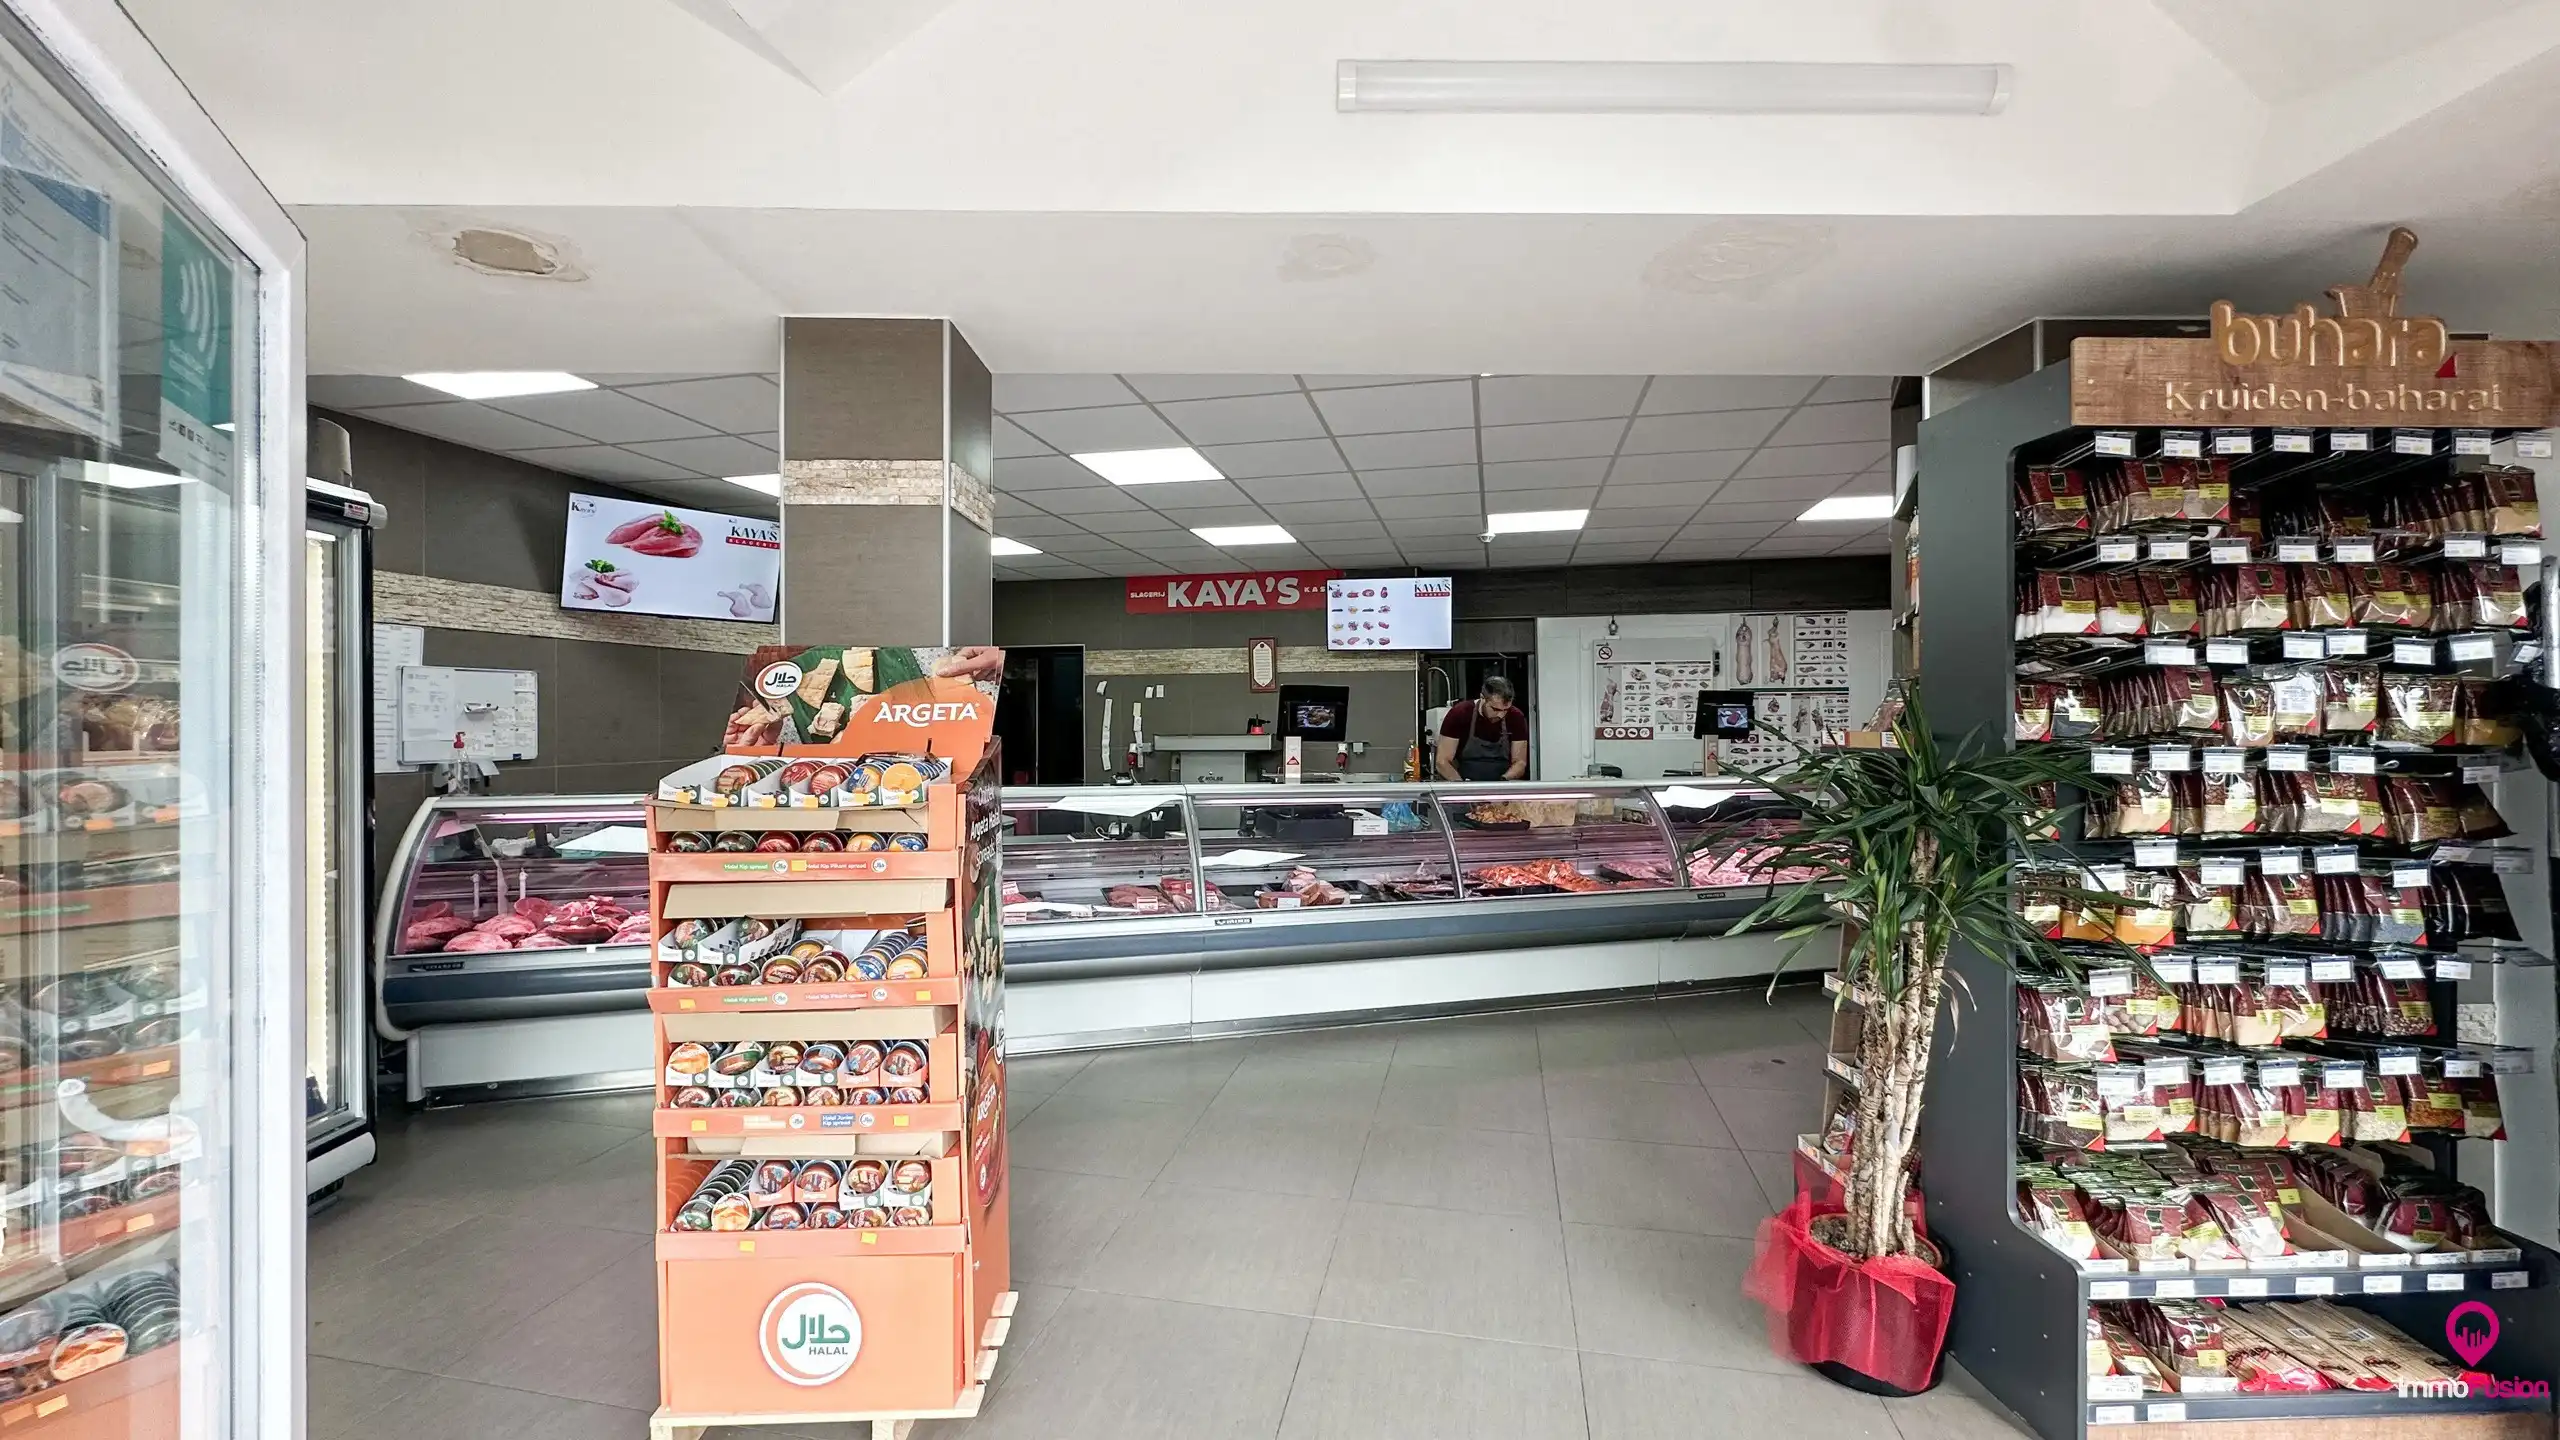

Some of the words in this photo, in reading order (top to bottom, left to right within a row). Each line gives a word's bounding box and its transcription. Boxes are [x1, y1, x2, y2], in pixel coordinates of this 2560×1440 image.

[2216, 302, 2447, 367] buhara
[2166, 382, 2503, 412] Kruiden-baharat
[731, 526, 778, 541] KAYA'S
[1130, 591, 1166, 599] SLAGERIJ
[1168, 577, 1300, 608] KAYA'S
[765, 672, 797, 686] حلال
[873, 702, 978, 728] ARGETA
[970, 814, 988, 842] Argeta
[782, 1314, 851, 1349] حلال
[809, 1347, 848, 1355] HALAL
